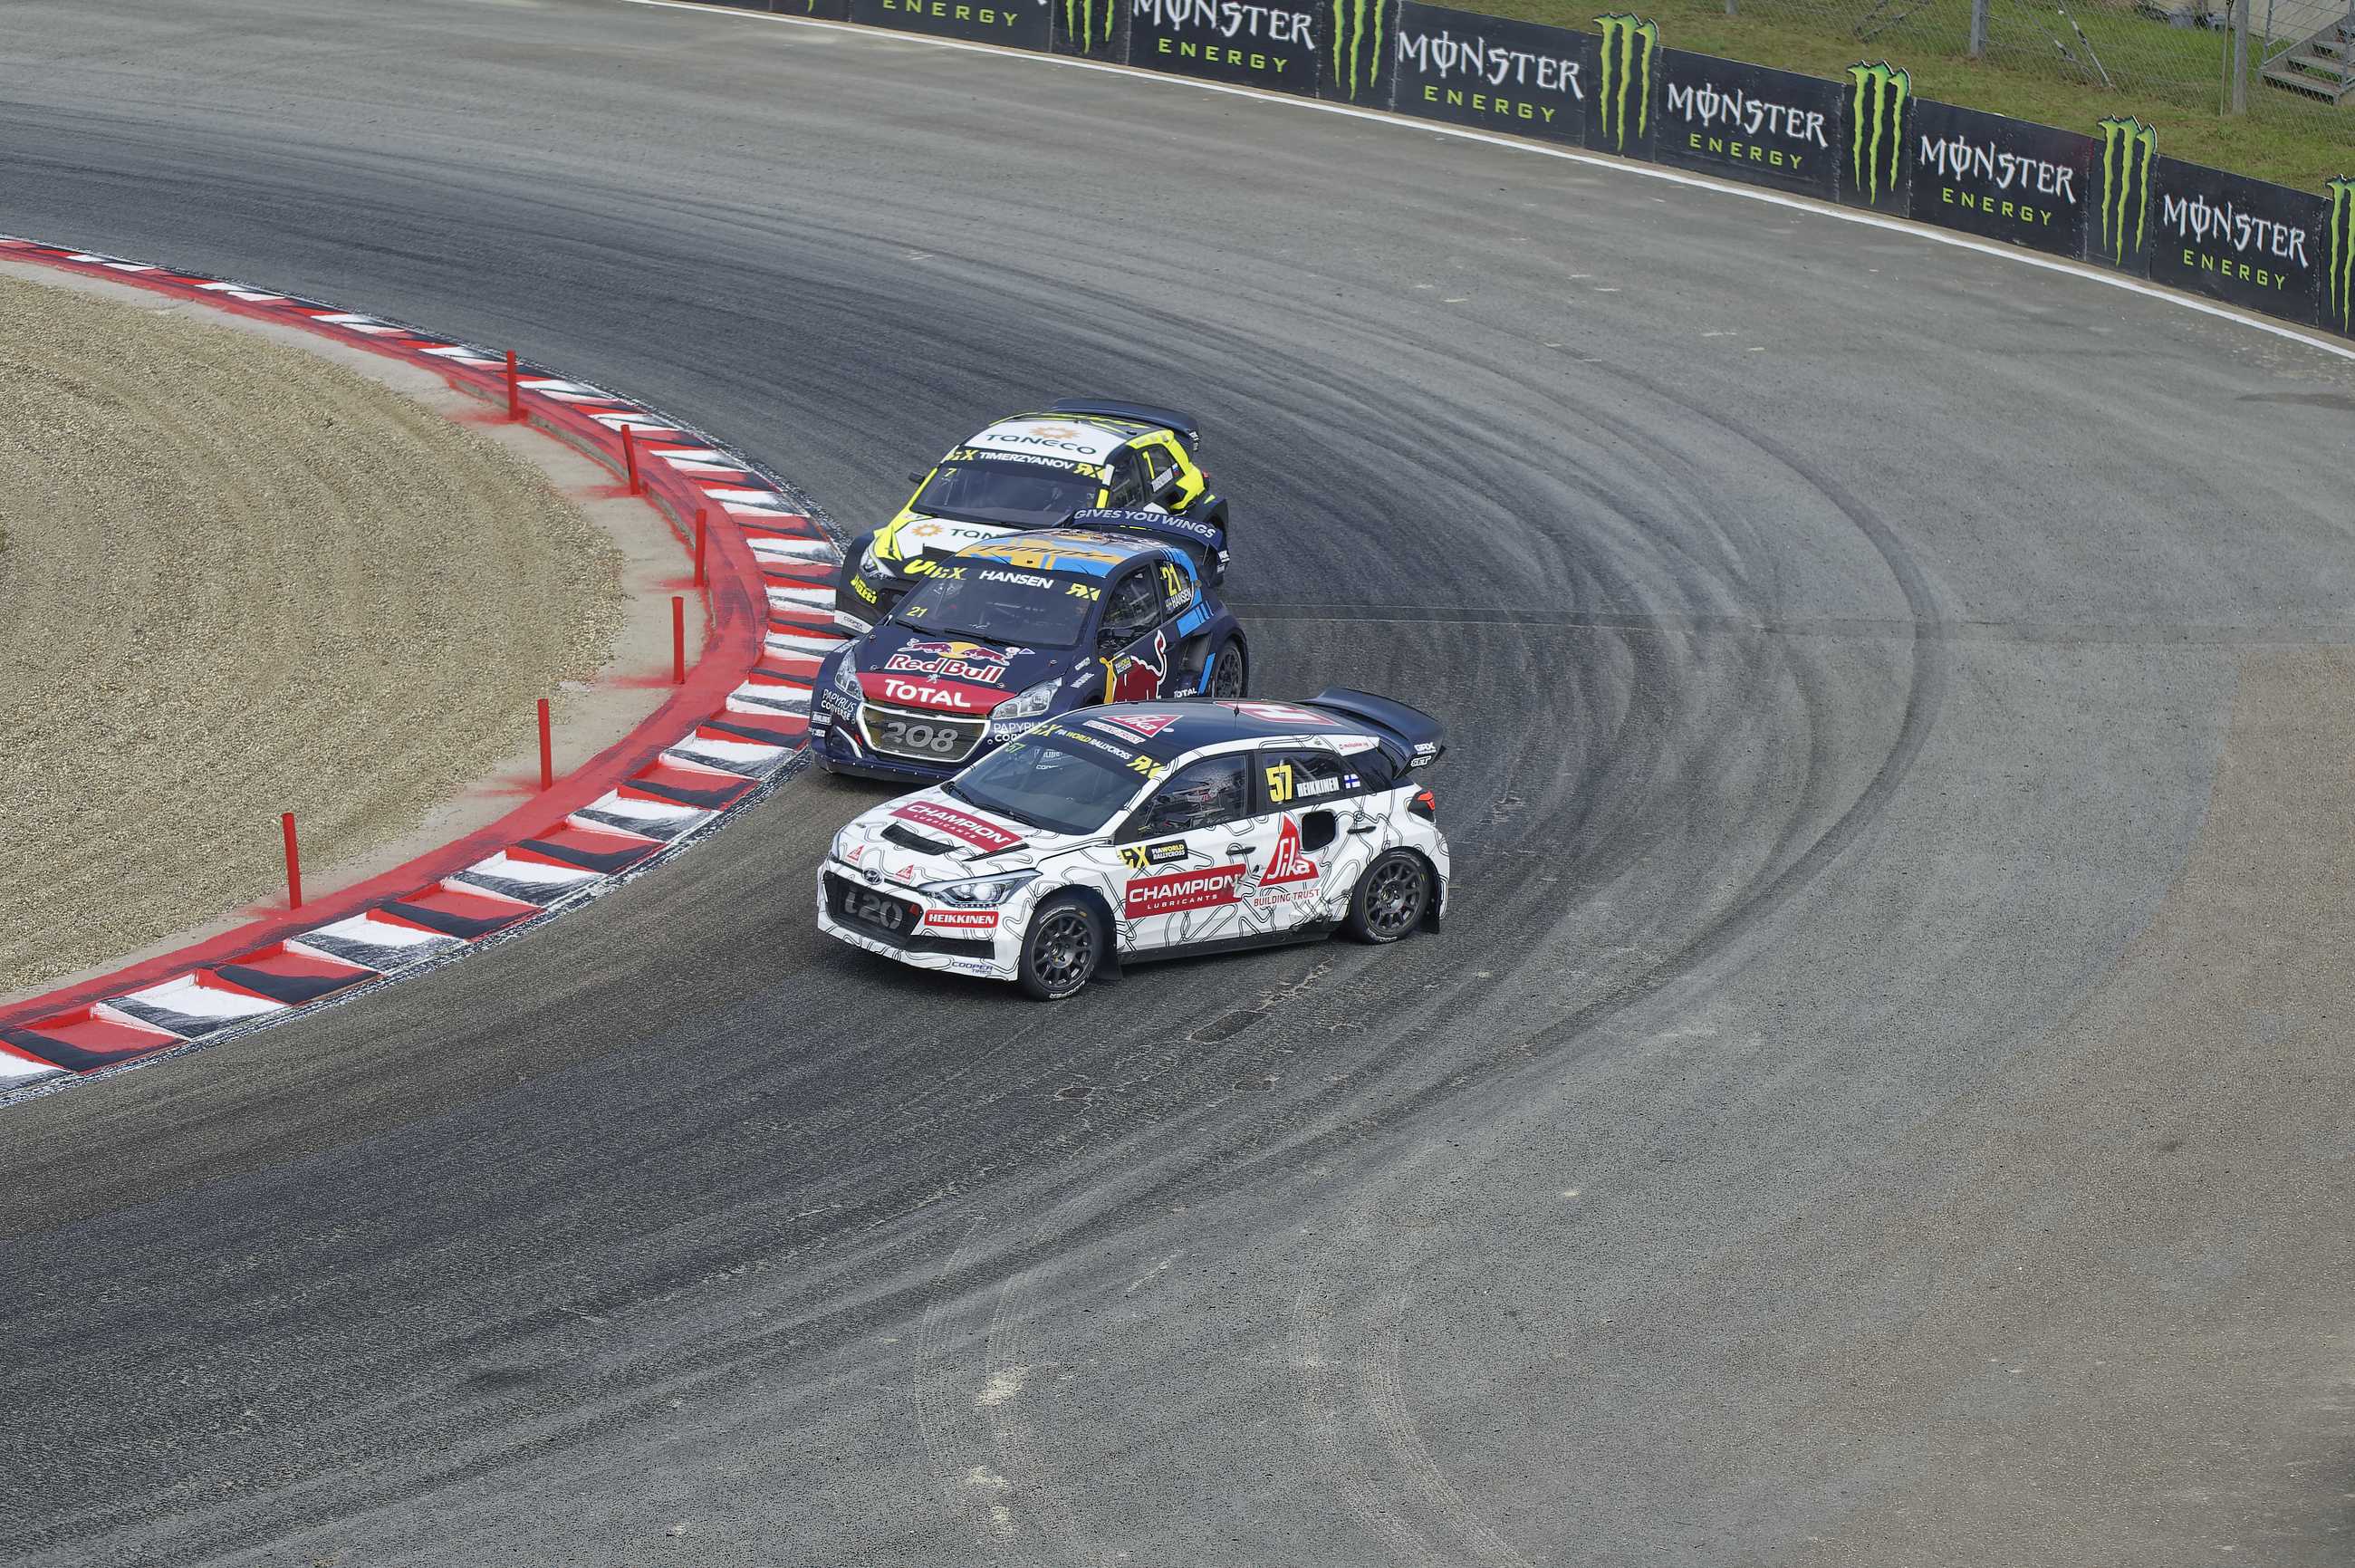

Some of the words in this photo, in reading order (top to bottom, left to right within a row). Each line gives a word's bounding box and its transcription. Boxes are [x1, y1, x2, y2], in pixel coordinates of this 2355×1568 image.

[882, 0, 1018, 26] ENERGY
[1132, 0, 1315, 50] MONSTER
[1158, 38, 1288, 72] ENERGY
[1398, 31, 1584, 101] MONSTER
[1424, 85, 1556, 123] ENERGY
[1668, 82, 1829, 149] MONSTER
[1689, 132, 1803, 169] ENERGY
[1919, 135, 2077, 205] MONSTER
[1942, 188, 2052, 226] ENERGY
[2163, 193, 2310, 269] MONSTER
[2183, 249, 2286, 290] ENERGY
[986, 434, 1097, 455] TANECO
[945, 467, 957, 477] 7
[979, 451, 1075, 470] TIMERZYANOV
[1073, 508, 1121, 520] GIVES
[1124, 510, 1162, 523] YOU
[1161, 515, 1217, 539] WINGS
[979, 571, 1055, 590] HANSEN
[1160, 563, 1182, 597] 21
[907, 606, 928, 617] 21
[884, 654, 946, 673] Red
[938, 659, 1006, 684] Bull
[822, 688, 857, 713] PAPYRUS
[885, 678, 971, 708] TOTAL
[1174, 687, 1197, 698] TOTAL
[881, 721, 959, 753] 208
[1089, 738, 1132, 760] RALLYCROSS
[1265, 765, 1293, 803] 57
[907, 804, 1012, 843] CHAMPION
[1266, 837, 1311, 880] Sika
[1129, 874, 1238, 903] CHAMPION
[1147, 894, 1218, 909] LUBRICANTS
[1254, 893, 1291, 907] BUILDING
[1292, 889, 1320, 900] TRUST
[928, 914, 995, 925] HEIKKINEN
[951, 960, 994, 972] COOPER
